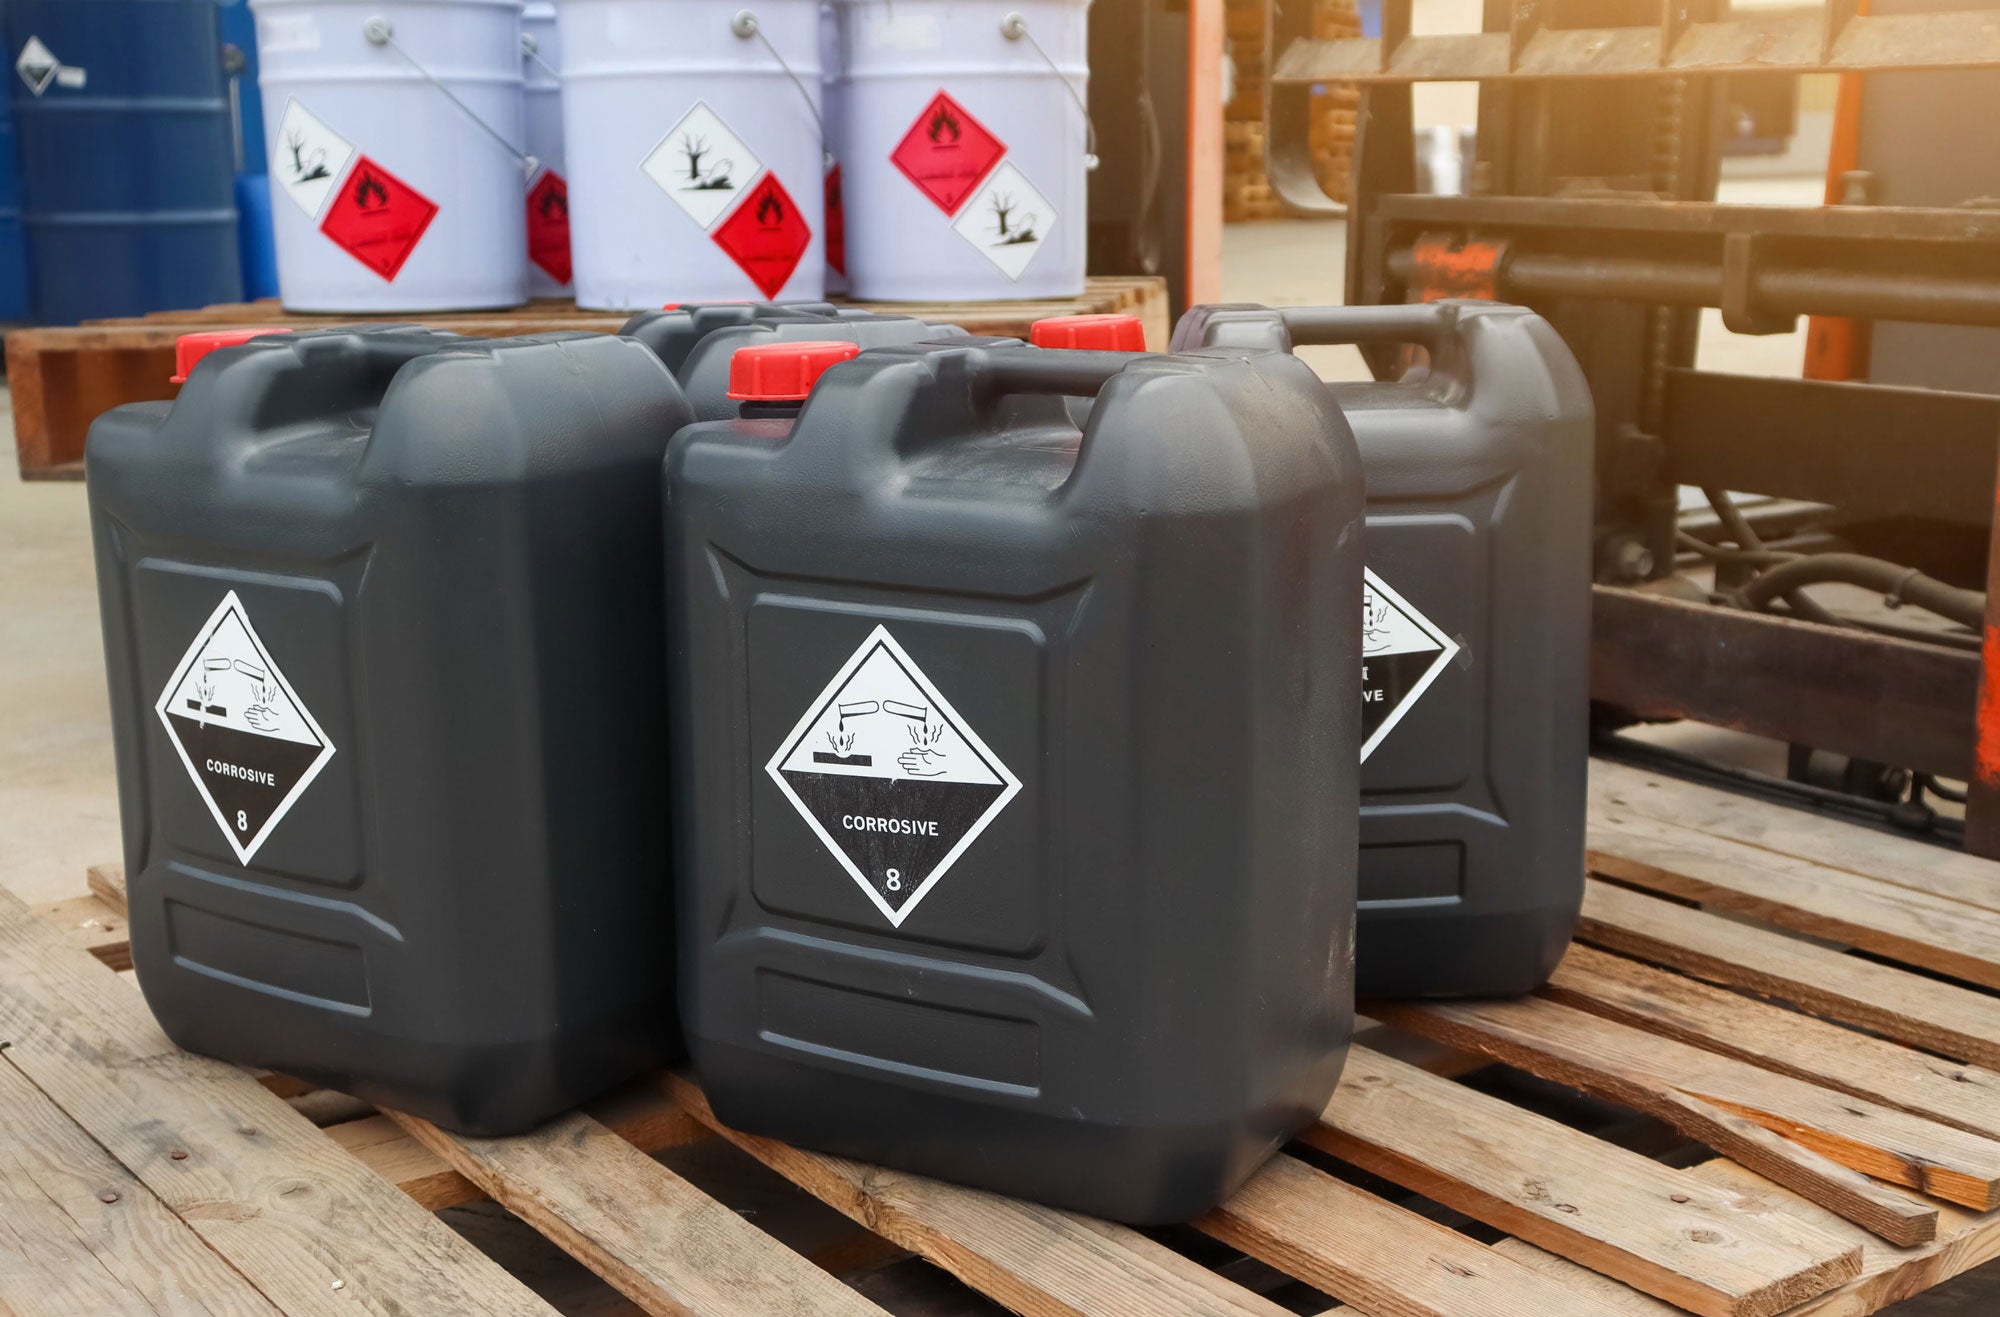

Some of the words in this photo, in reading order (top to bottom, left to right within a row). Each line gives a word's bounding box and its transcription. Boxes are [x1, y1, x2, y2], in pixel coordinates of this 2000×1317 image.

[207, 758, 275, 786] CORROSIVE
[237, 809, 248, 831] 8
[842, 814, 939, 836] CORROSIVE
[885, 868, 901, 891] 8
